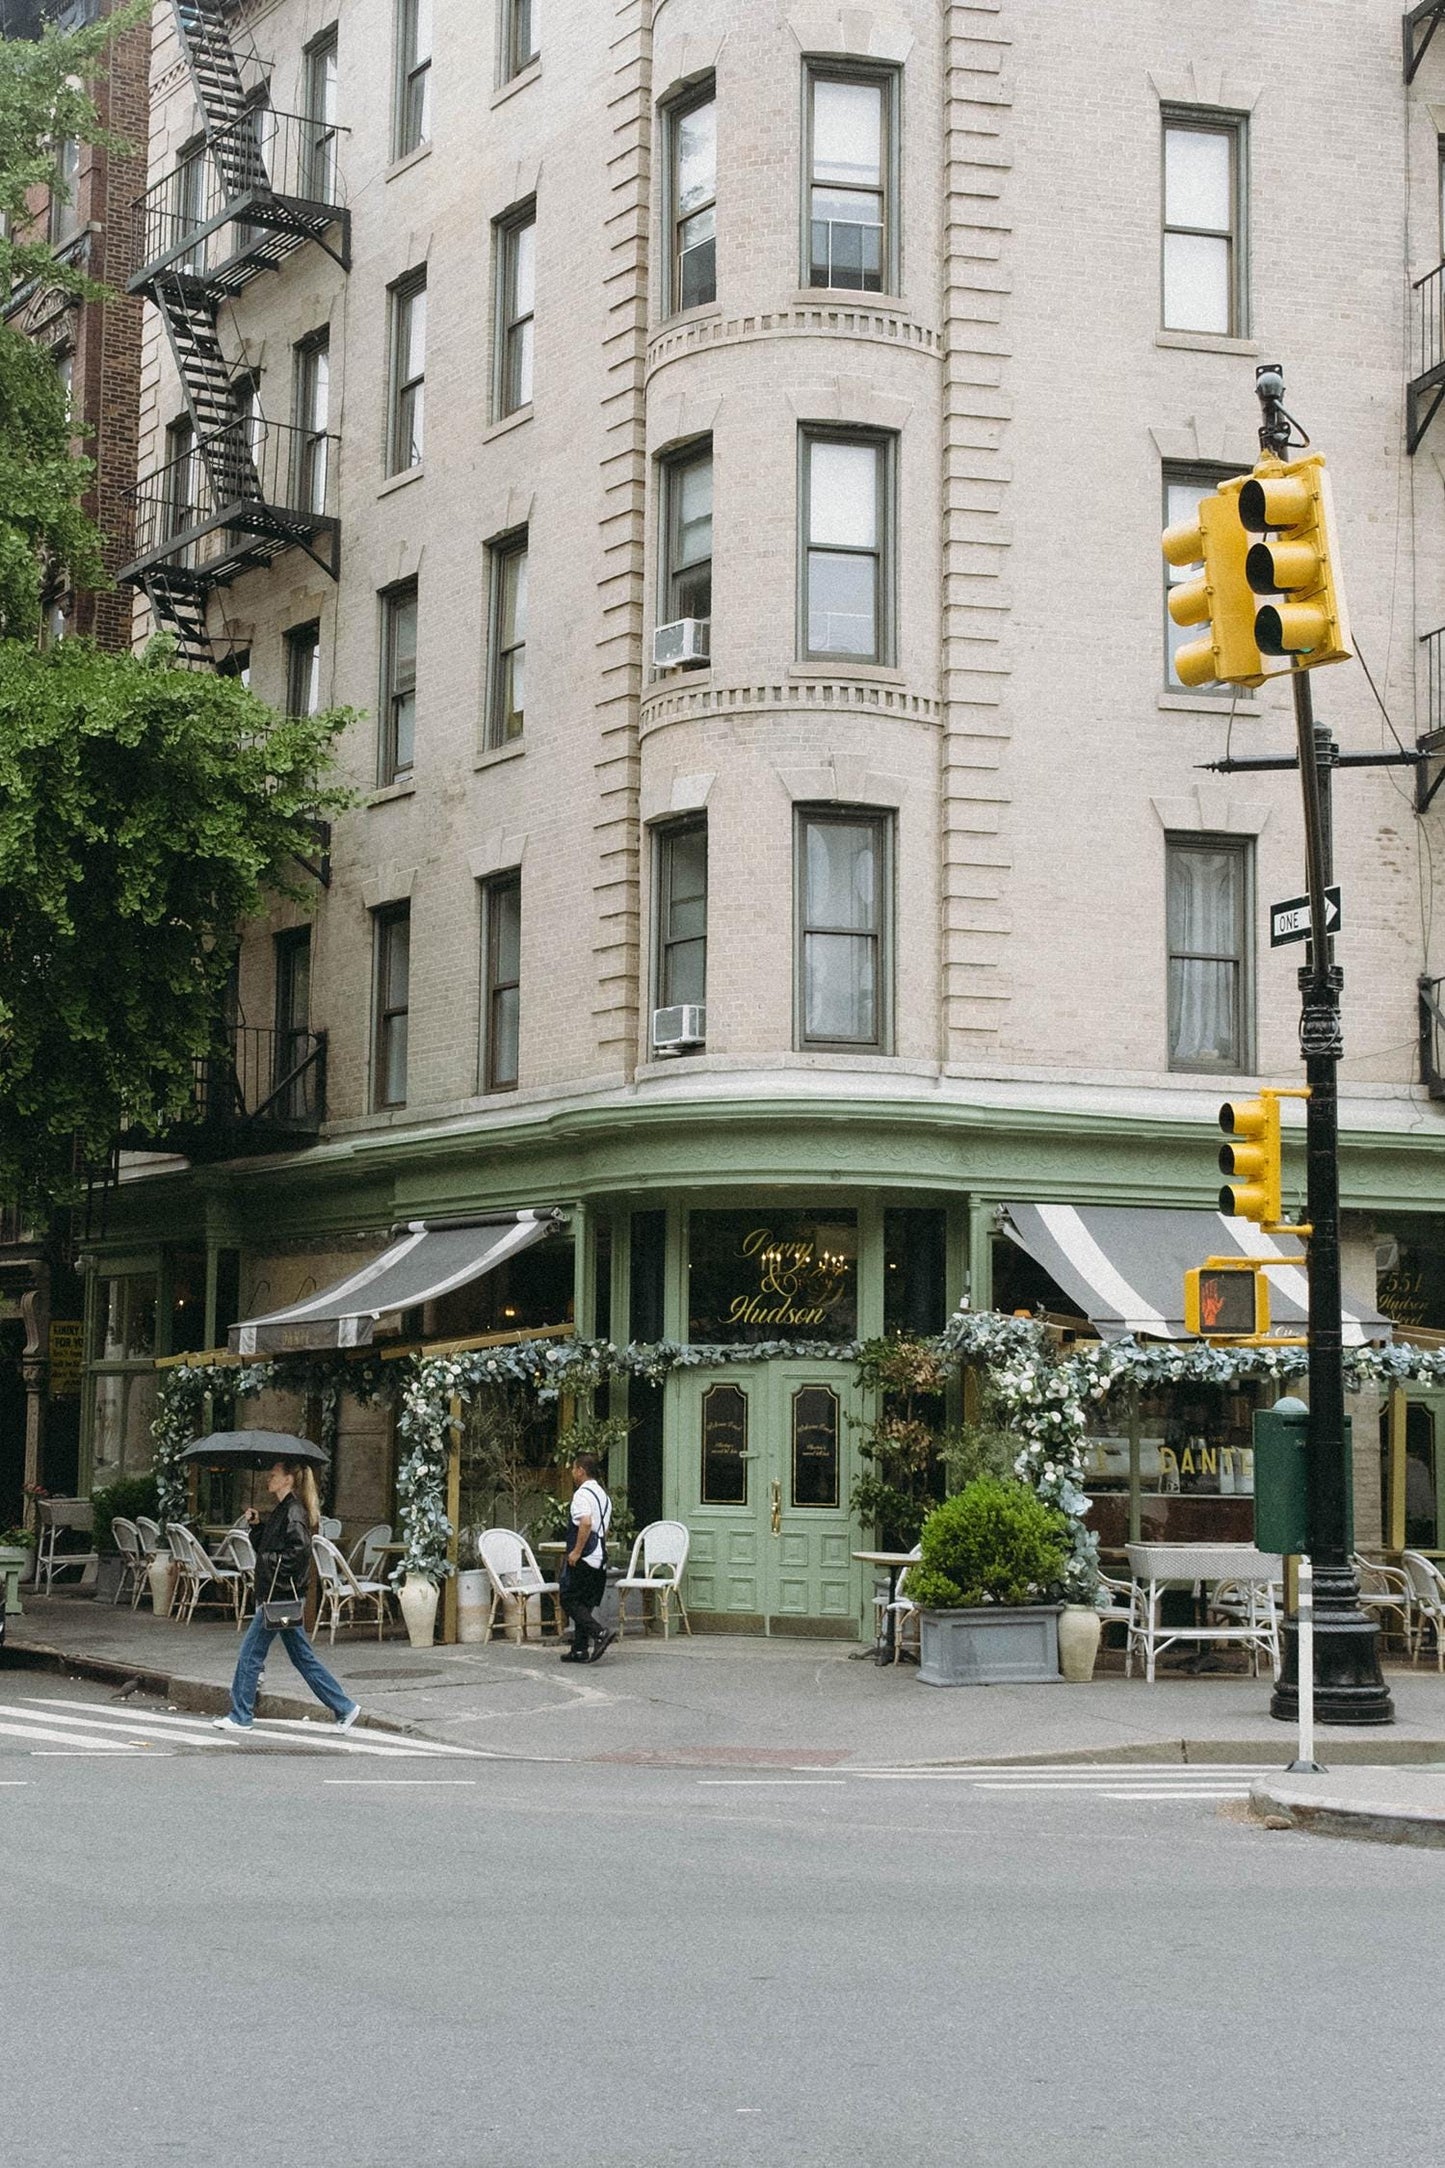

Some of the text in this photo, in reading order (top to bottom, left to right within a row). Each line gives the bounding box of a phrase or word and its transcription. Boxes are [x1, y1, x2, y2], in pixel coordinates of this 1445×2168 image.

[1280, 912, 1299, 932] ONE
[761, 1263, 798, 1297] &
[718, 1293, 828, 1325] Hudson
